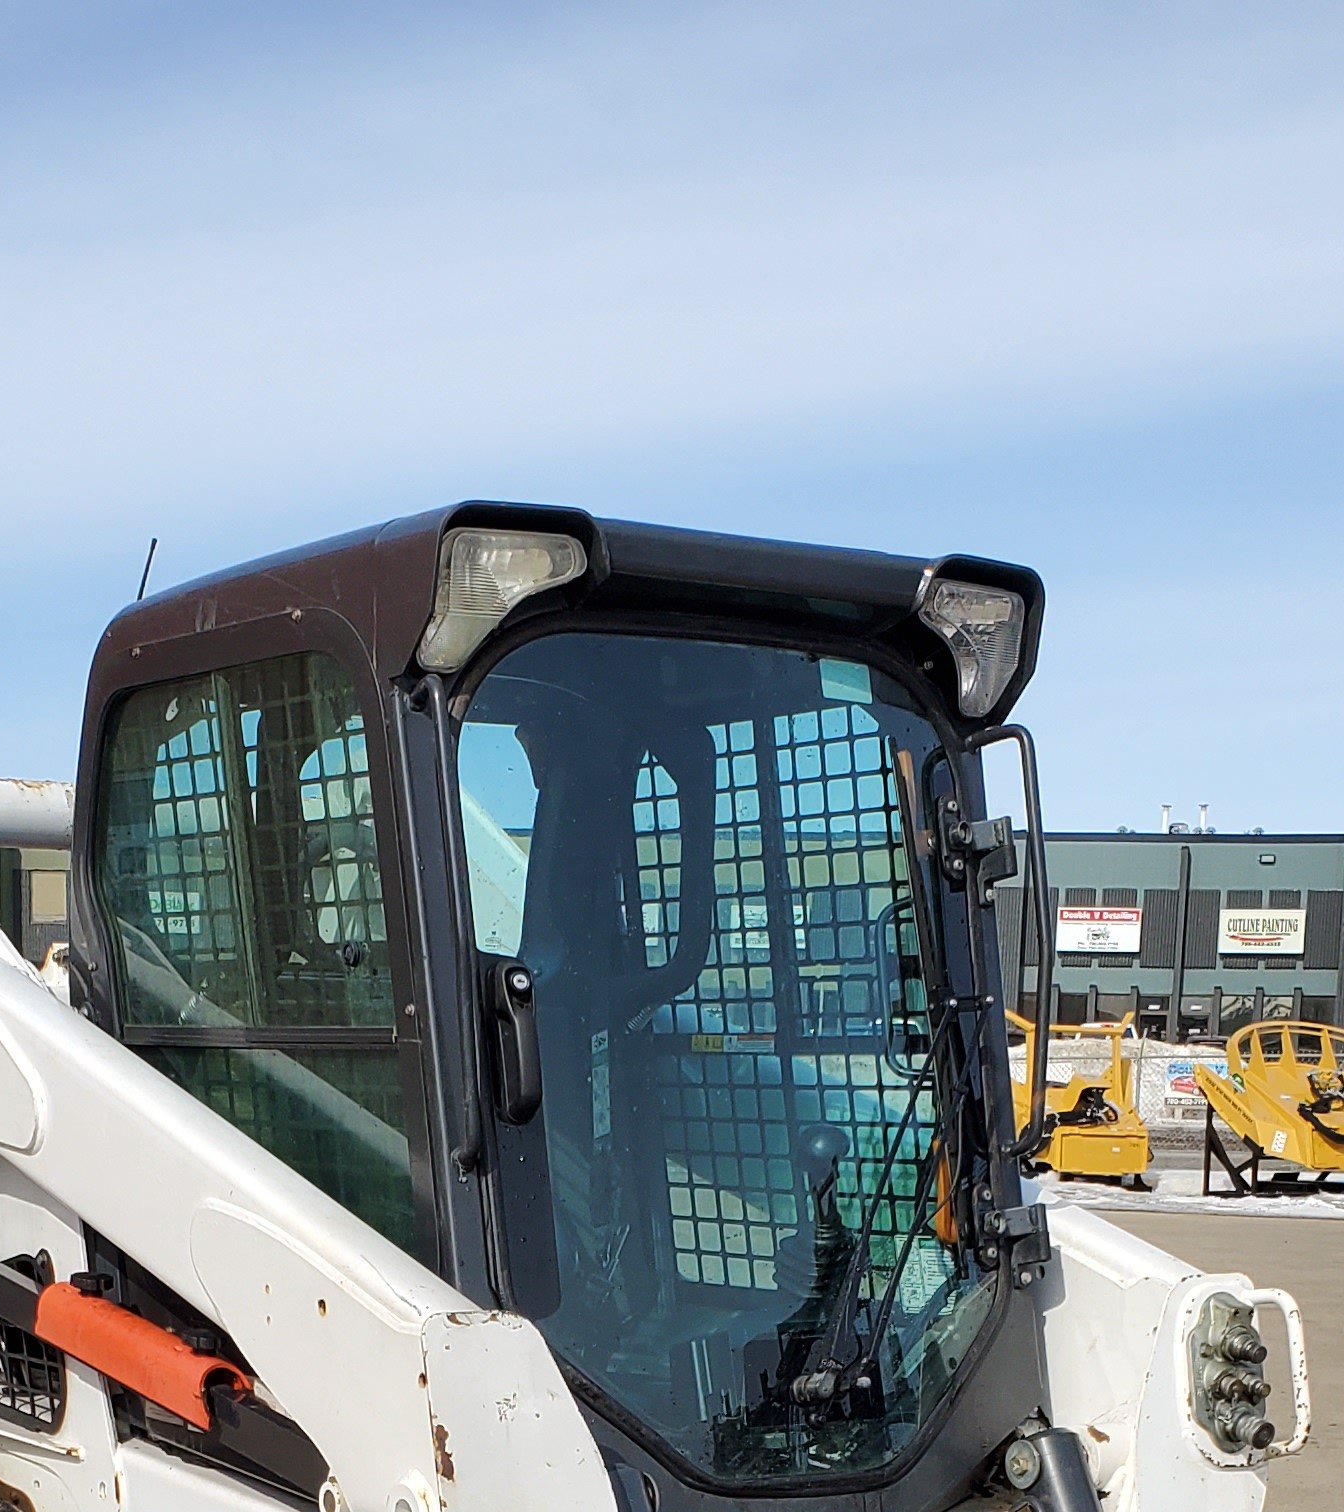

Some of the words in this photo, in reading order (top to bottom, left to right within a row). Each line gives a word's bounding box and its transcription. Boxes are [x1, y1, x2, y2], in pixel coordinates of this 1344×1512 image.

[1062, 911, 1090, 919] Double
[1094, 911, 1100, 919] V
[1103, 912, 1137, 921] Detailing
[1227, 918, 1260, 932] CUTLINE
[1262, 918, 1298, 932] PAINTING
